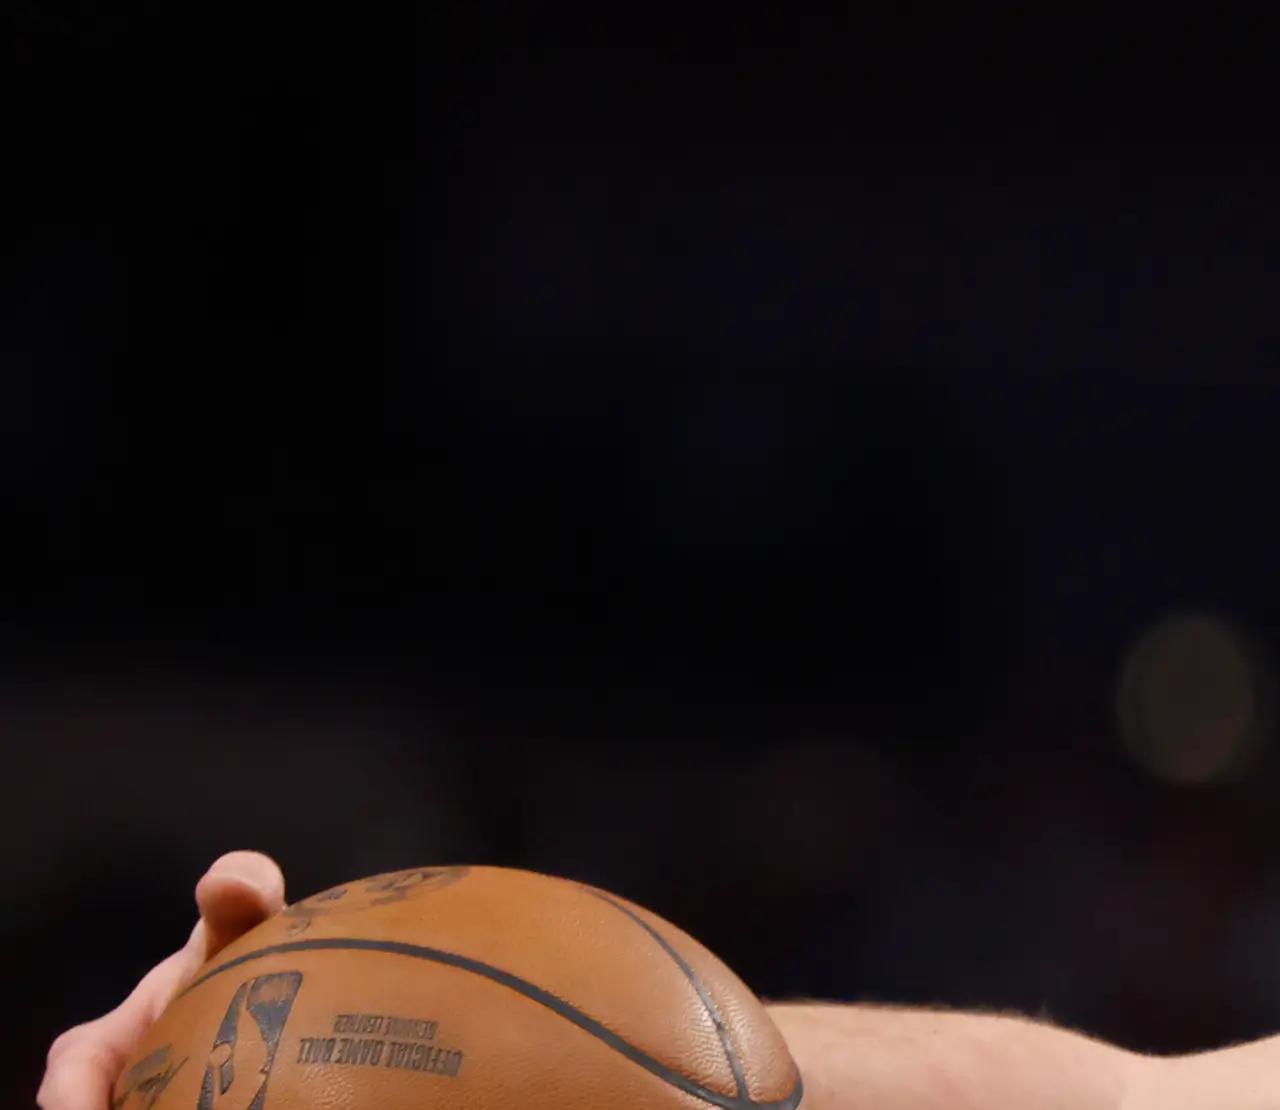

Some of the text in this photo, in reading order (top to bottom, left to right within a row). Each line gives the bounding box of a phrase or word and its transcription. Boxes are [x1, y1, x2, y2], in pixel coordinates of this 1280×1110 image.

[296, 1037, 464, 1079] OFFICIAL GAME BALL
